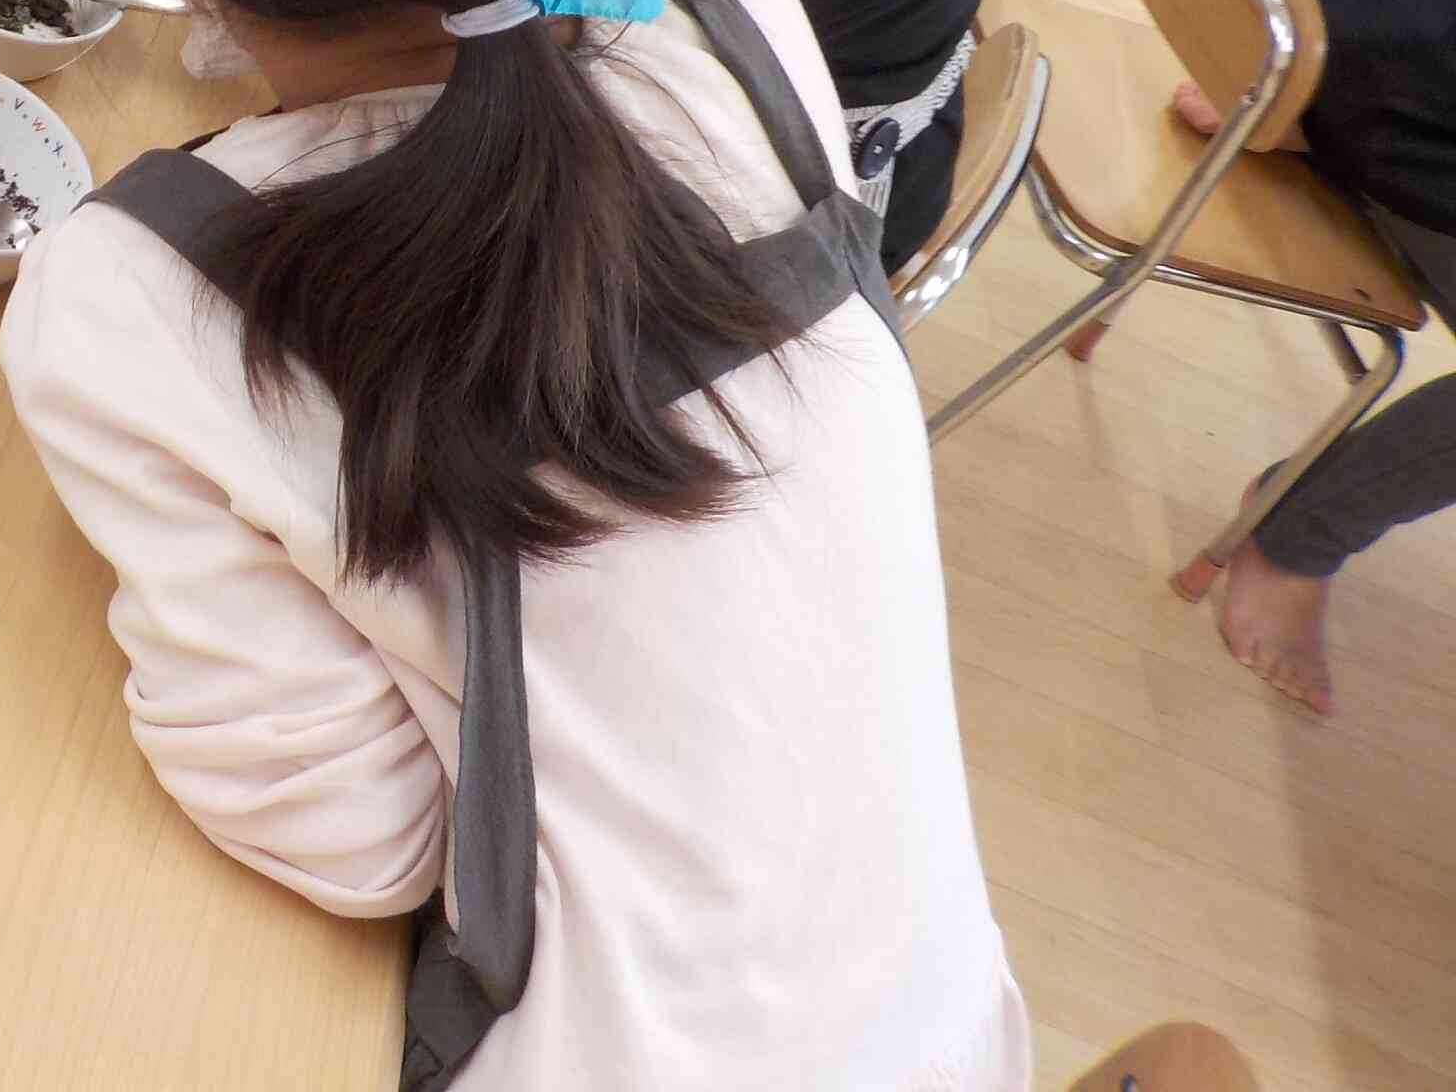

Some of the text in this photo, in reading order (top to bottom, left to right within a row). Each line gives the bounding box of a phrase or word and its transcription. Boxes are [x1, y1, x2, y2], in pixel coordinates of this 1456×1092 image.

[13, 97, 25, 111] V
[31, 116, 46, 133] W
[52, 141, 65, 157] X
